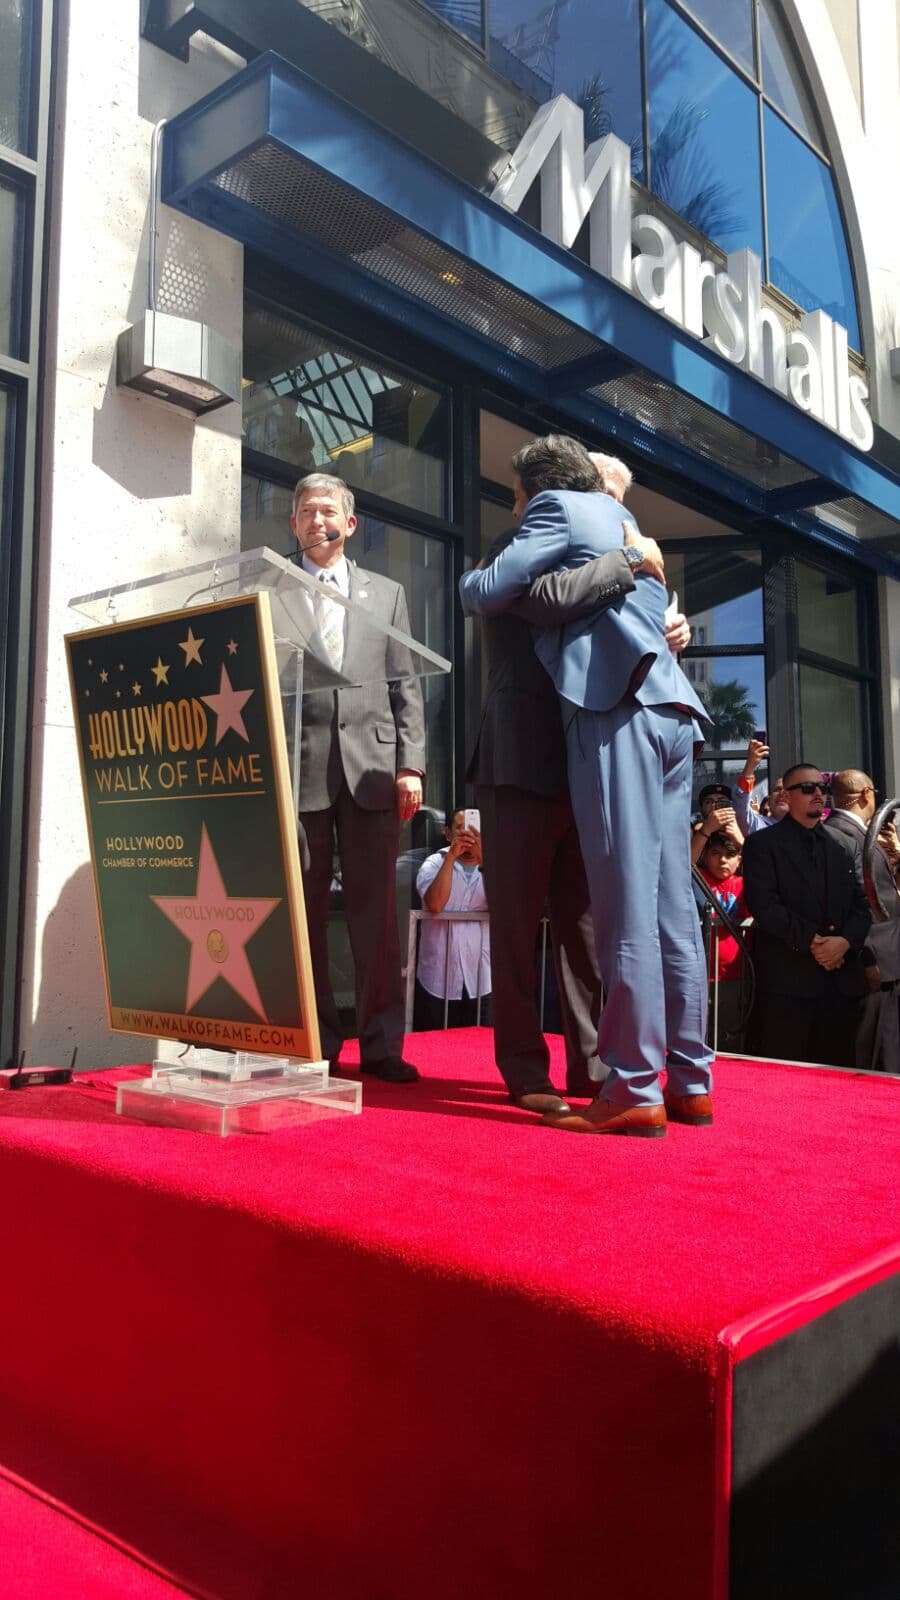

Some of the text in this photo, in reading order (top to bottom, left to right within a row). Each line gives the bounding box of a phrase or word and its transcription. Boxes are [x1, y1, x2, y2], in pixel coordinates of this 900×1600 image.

[490, 94, 874, 452] Marshalls
[89, 697, 208, 760] HOLLYWOOD
[94, 753, 264, 792] WALK OF FAME
[102, 856, 194, 868] CHAMBER OF COMMERCE
[106, 835, 184, 851] HOLLYWOOD
[175, 905, 255, 922] HOLLYWOOD
[120, 1010, 296, 1048] WWW.WALKOFFAME.COM
